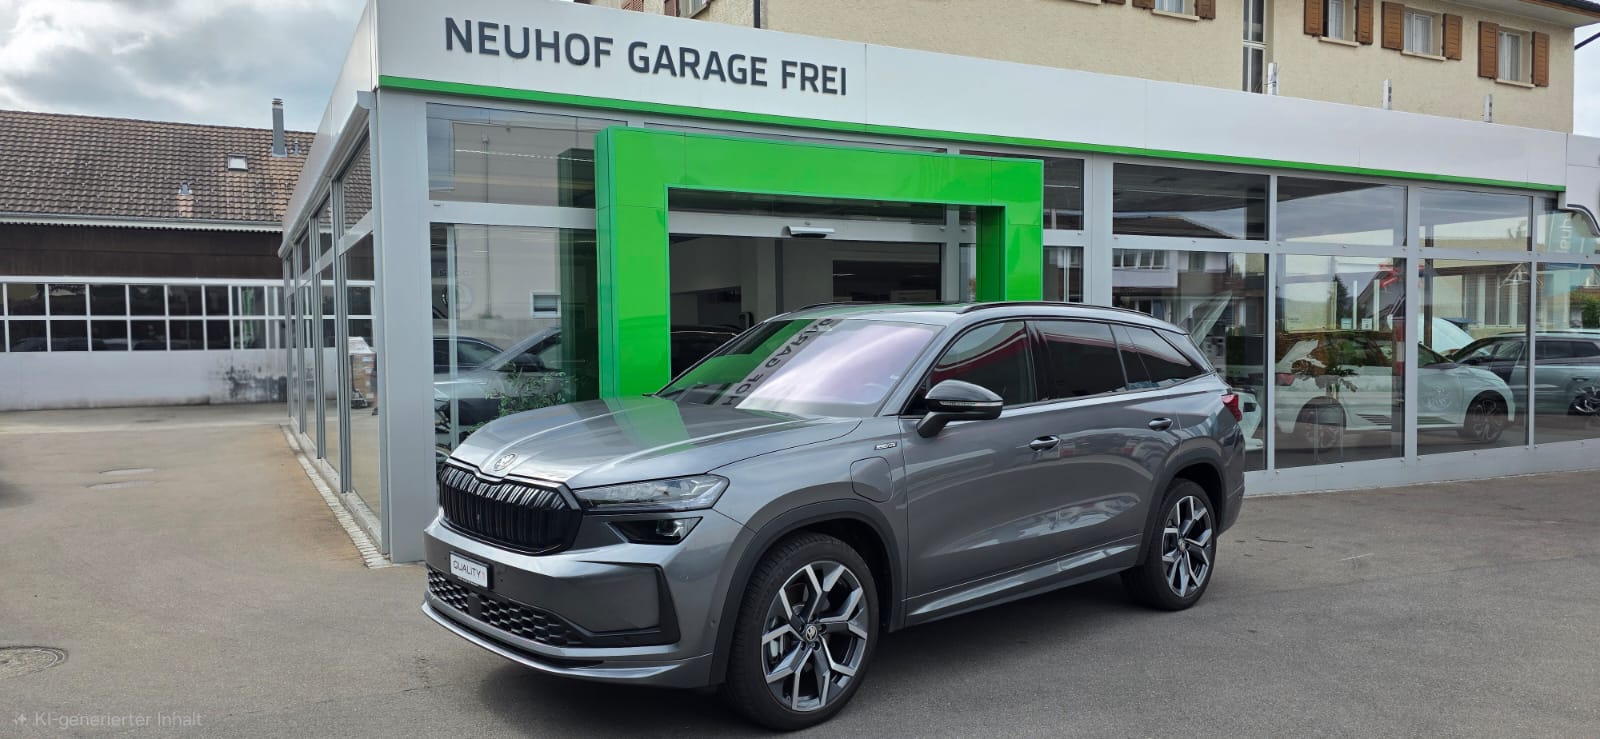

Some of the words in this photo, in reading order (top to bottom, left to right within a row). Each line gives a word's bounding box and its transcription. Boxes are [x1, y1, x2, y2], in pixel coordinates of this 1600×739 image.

[444, 16, 614, 68] NEUHOF
[628, 40, 768, 87] GARAGE
[781, 60, 847, 96] FREI
